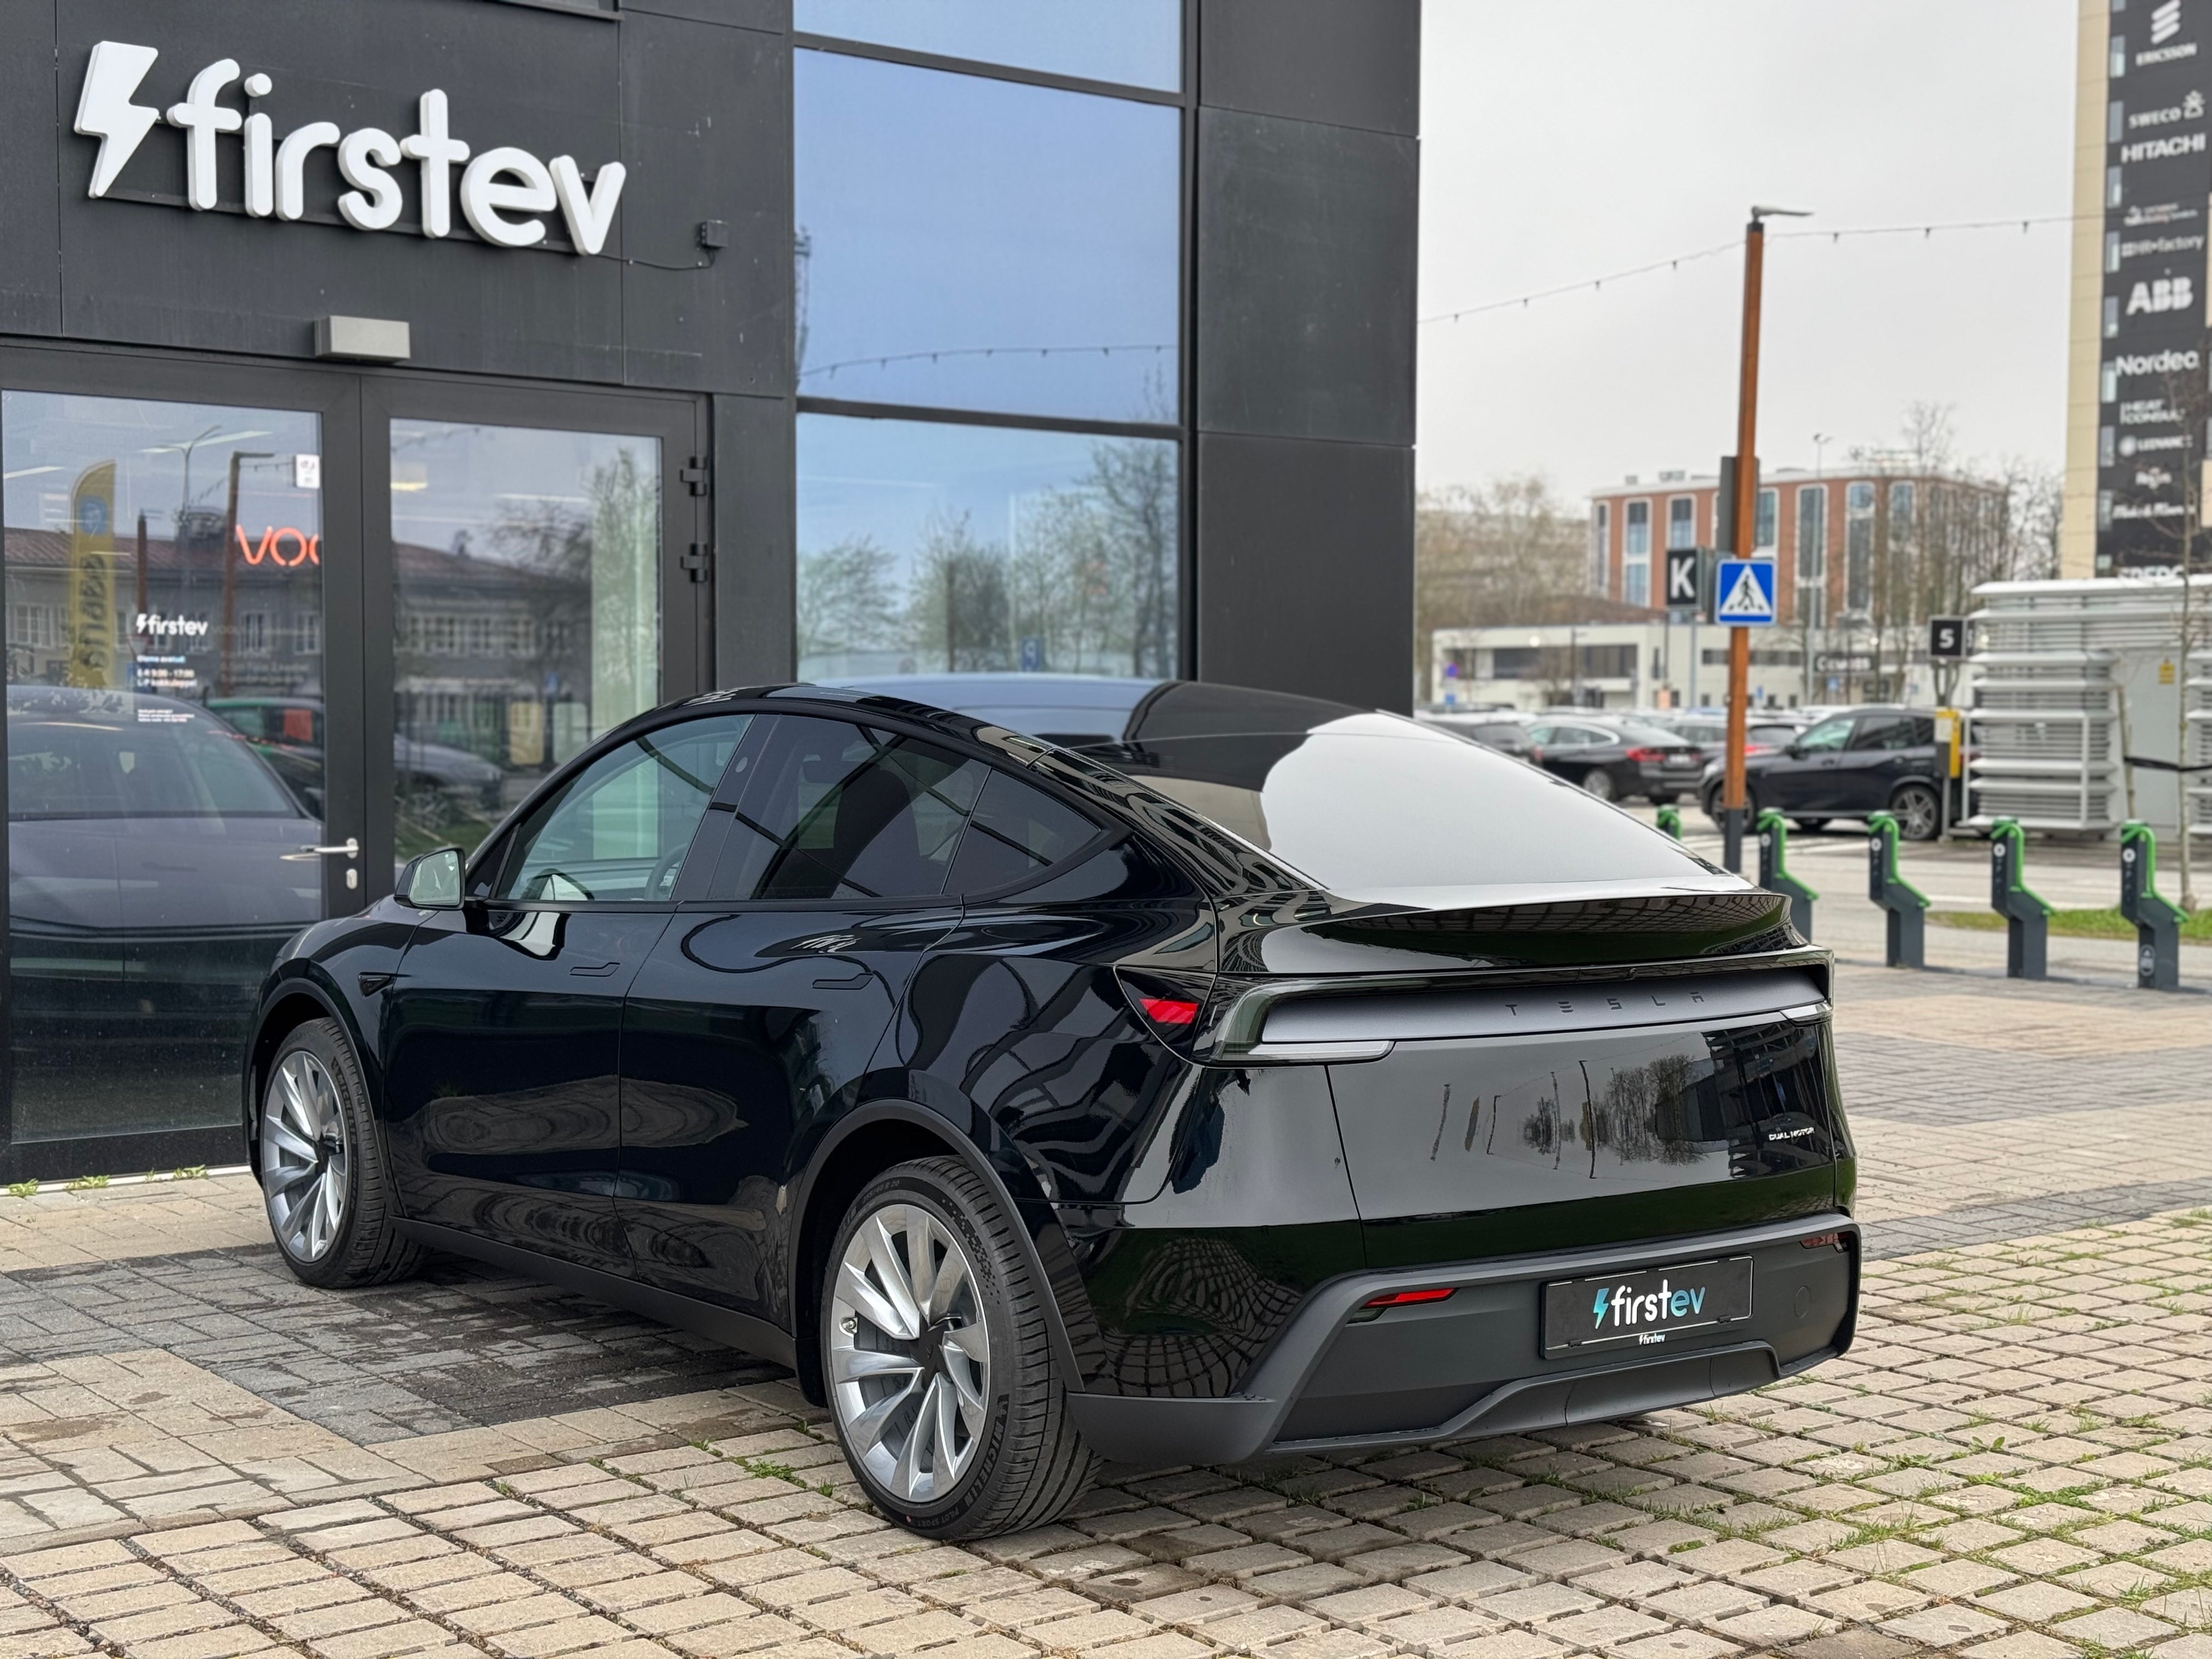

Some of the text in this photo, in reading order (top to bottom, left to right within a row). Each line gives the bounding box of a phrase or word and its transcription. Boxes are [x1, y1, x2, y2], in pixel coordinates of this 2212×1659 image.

[2135, 42, 2197, 66] ERICSSON
[2129, 107, 2182, 129] SWECO
[166, 58, 626, 256] firstev
[2121, 133, 2206, 163] HITACHI
[2126, 276, 2193, 316] ABB
[1671, 557, 1696, 599] K
[148, 614, 208, 636] firstev
[1769, 1127, 1815, 1141] DUAL MOTOR
[1611, 1279, 1706, 1327] firstev
[1644, 1333, 1666, 1345] firstev
[964, 1421, 1005, 1508] MICHELIN
[917, 1508, 959, 1527] PILOT SPORT
